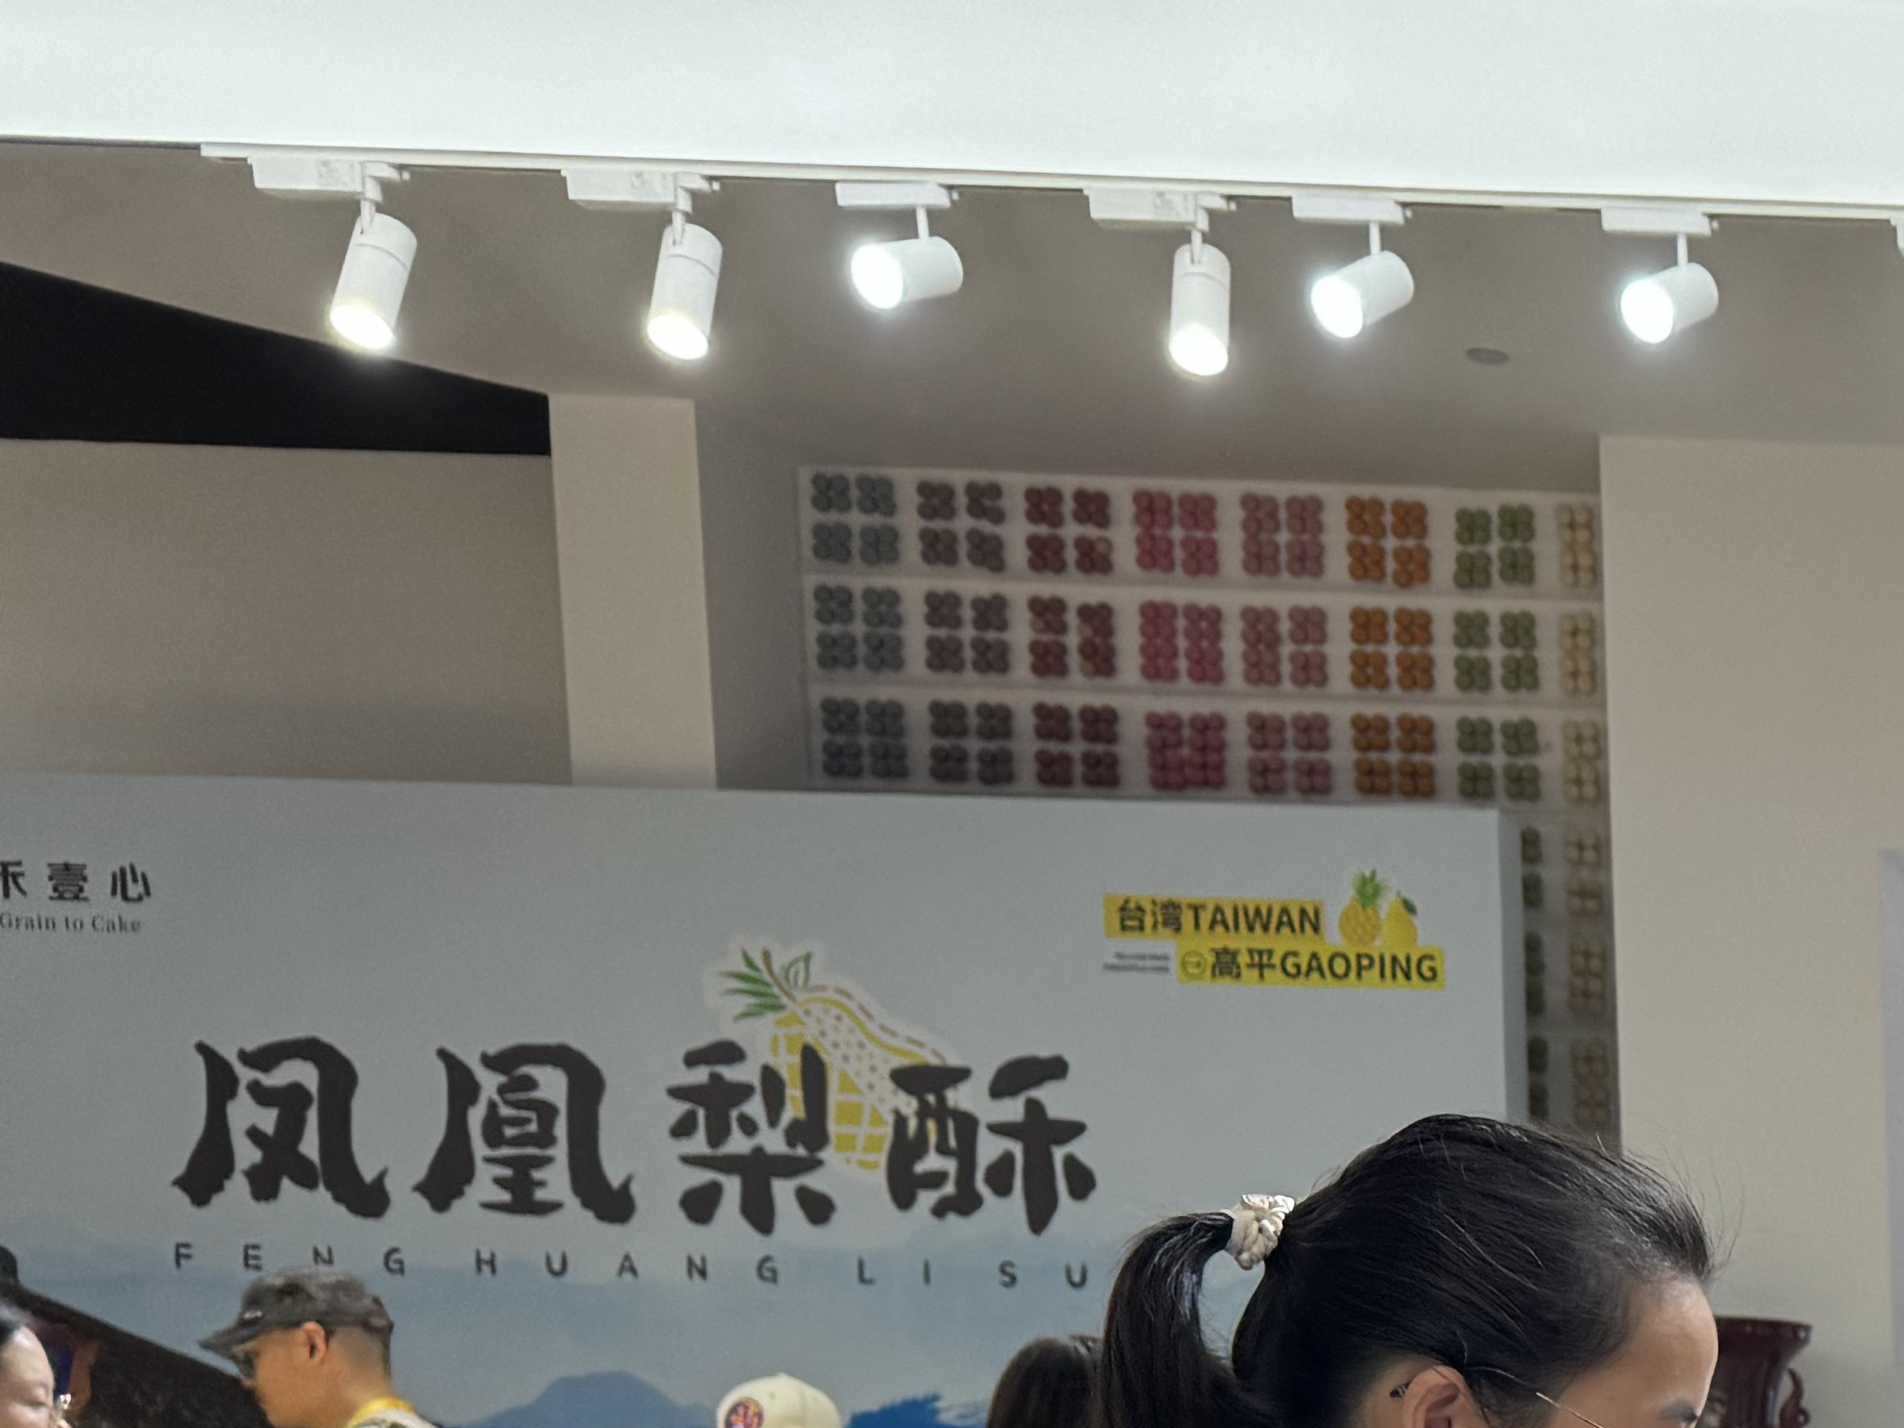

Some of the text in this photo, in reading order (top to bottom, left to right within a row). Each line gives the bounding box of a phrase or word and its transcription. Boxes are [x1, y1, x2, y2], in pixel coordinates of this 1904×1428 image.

[64, 916, 84, 931] to
[91, 914, 141, 933] Cake
[1118, 897, 1321, 935] 台湾TAIWAN
[1210, 946, 1438, 982] 高平GAOPING
[172, 1035, 1097, 1236] 凤凰梨酥
